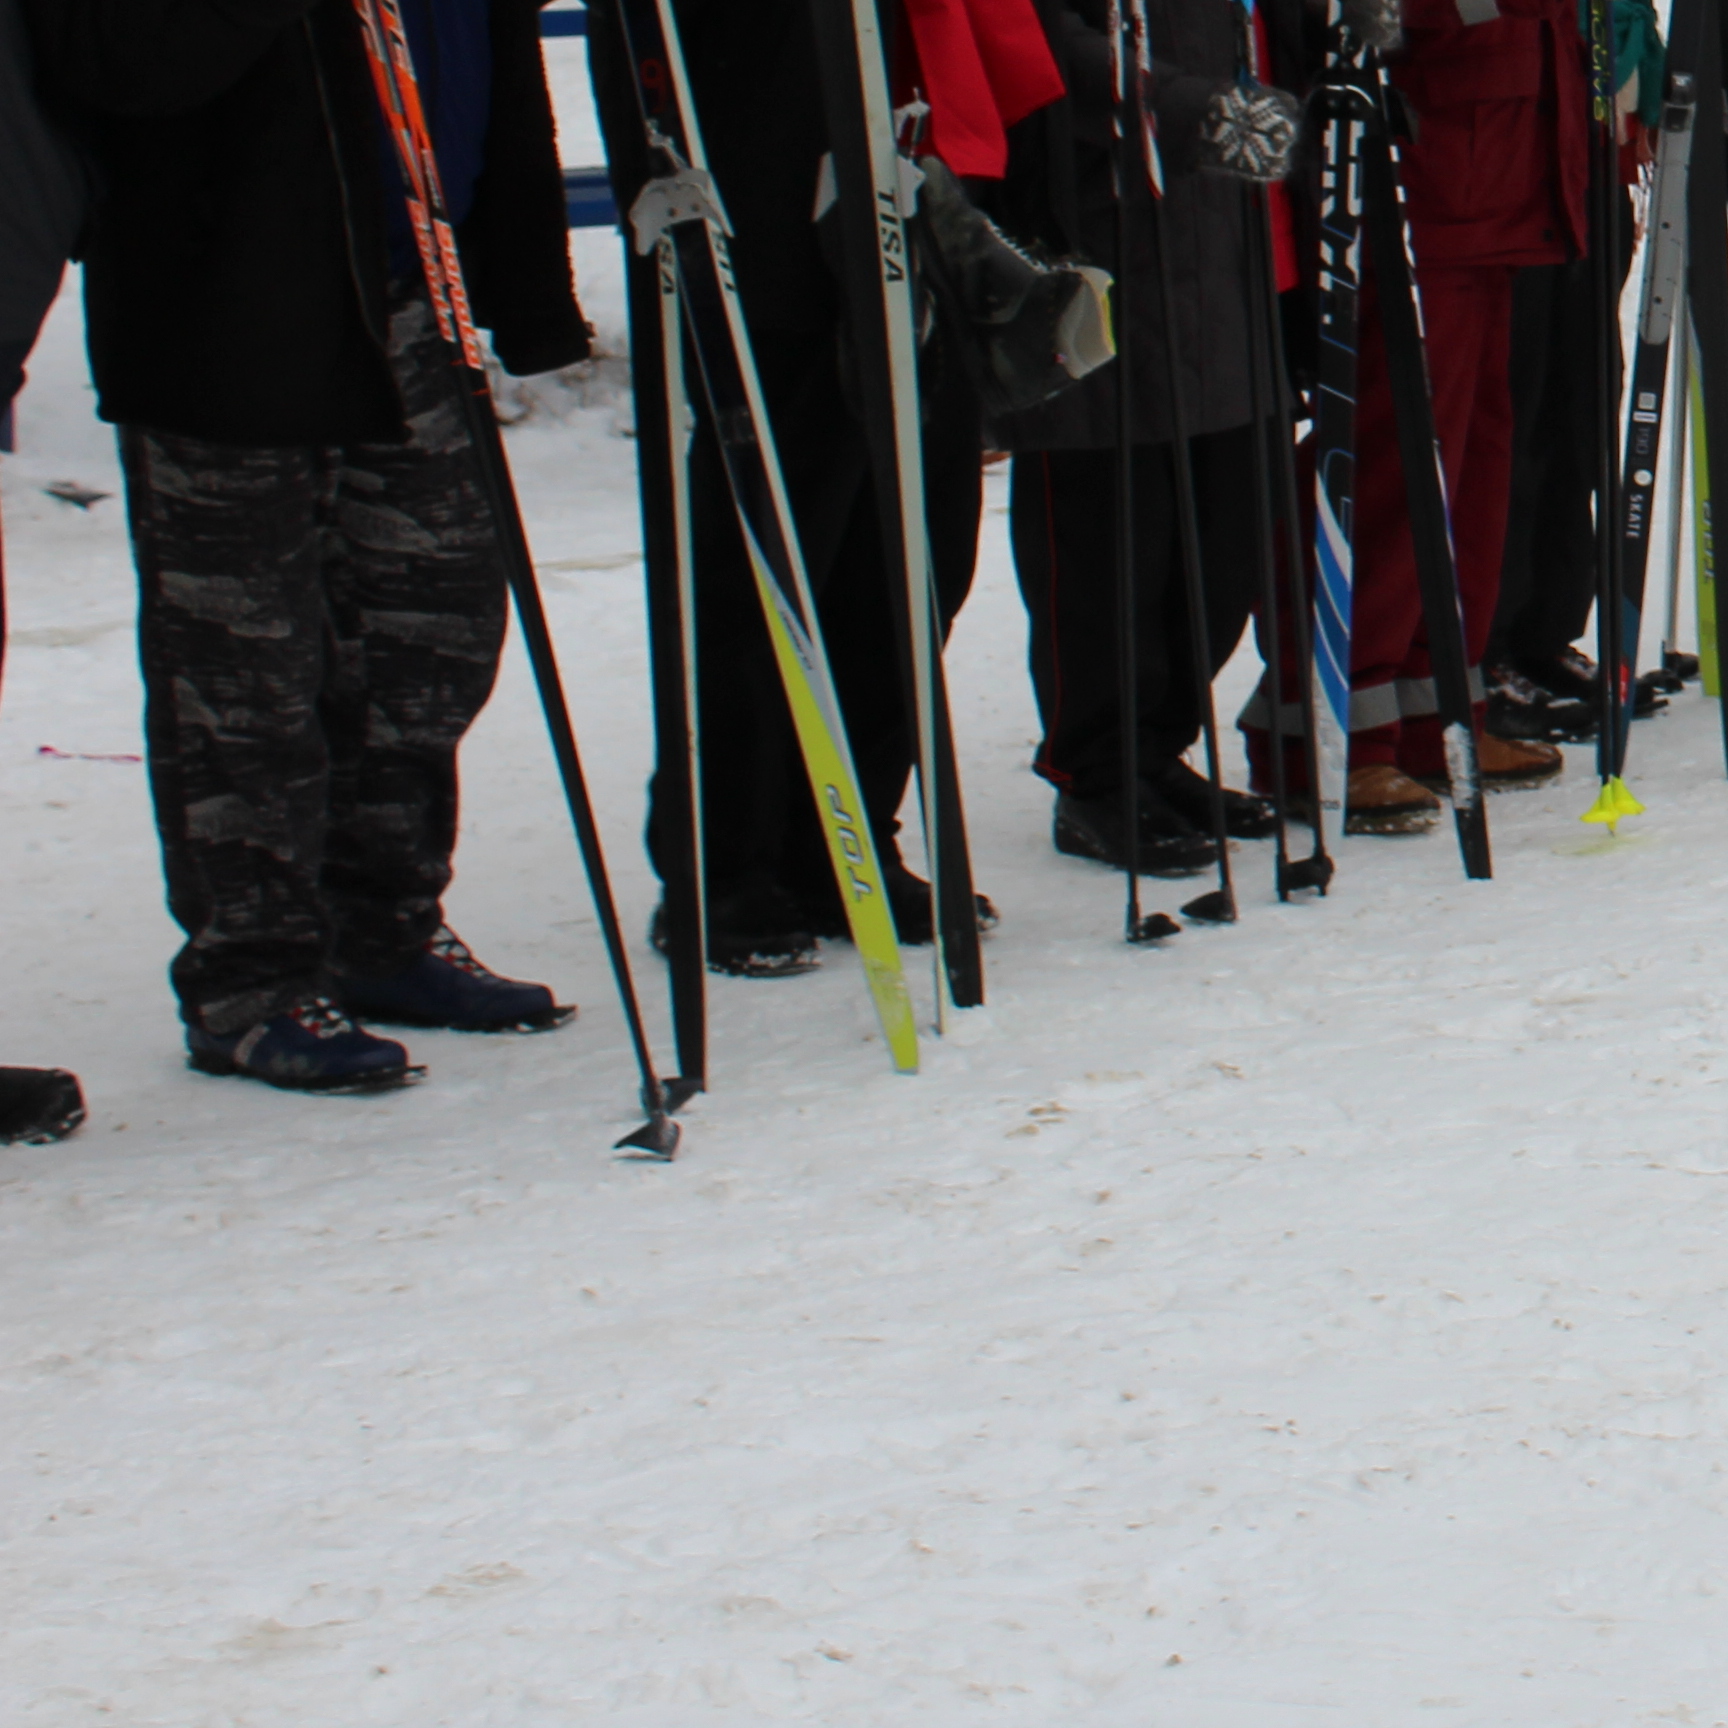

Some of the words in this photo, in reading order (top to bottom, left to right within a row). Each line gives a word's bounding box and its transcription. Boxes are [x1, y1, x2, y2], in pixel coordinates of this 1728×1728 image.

[878, 187, 905, 283] TISA
[1626, 494, 1643, 539] SKATE
[825, 783, 873, 903] TOP
